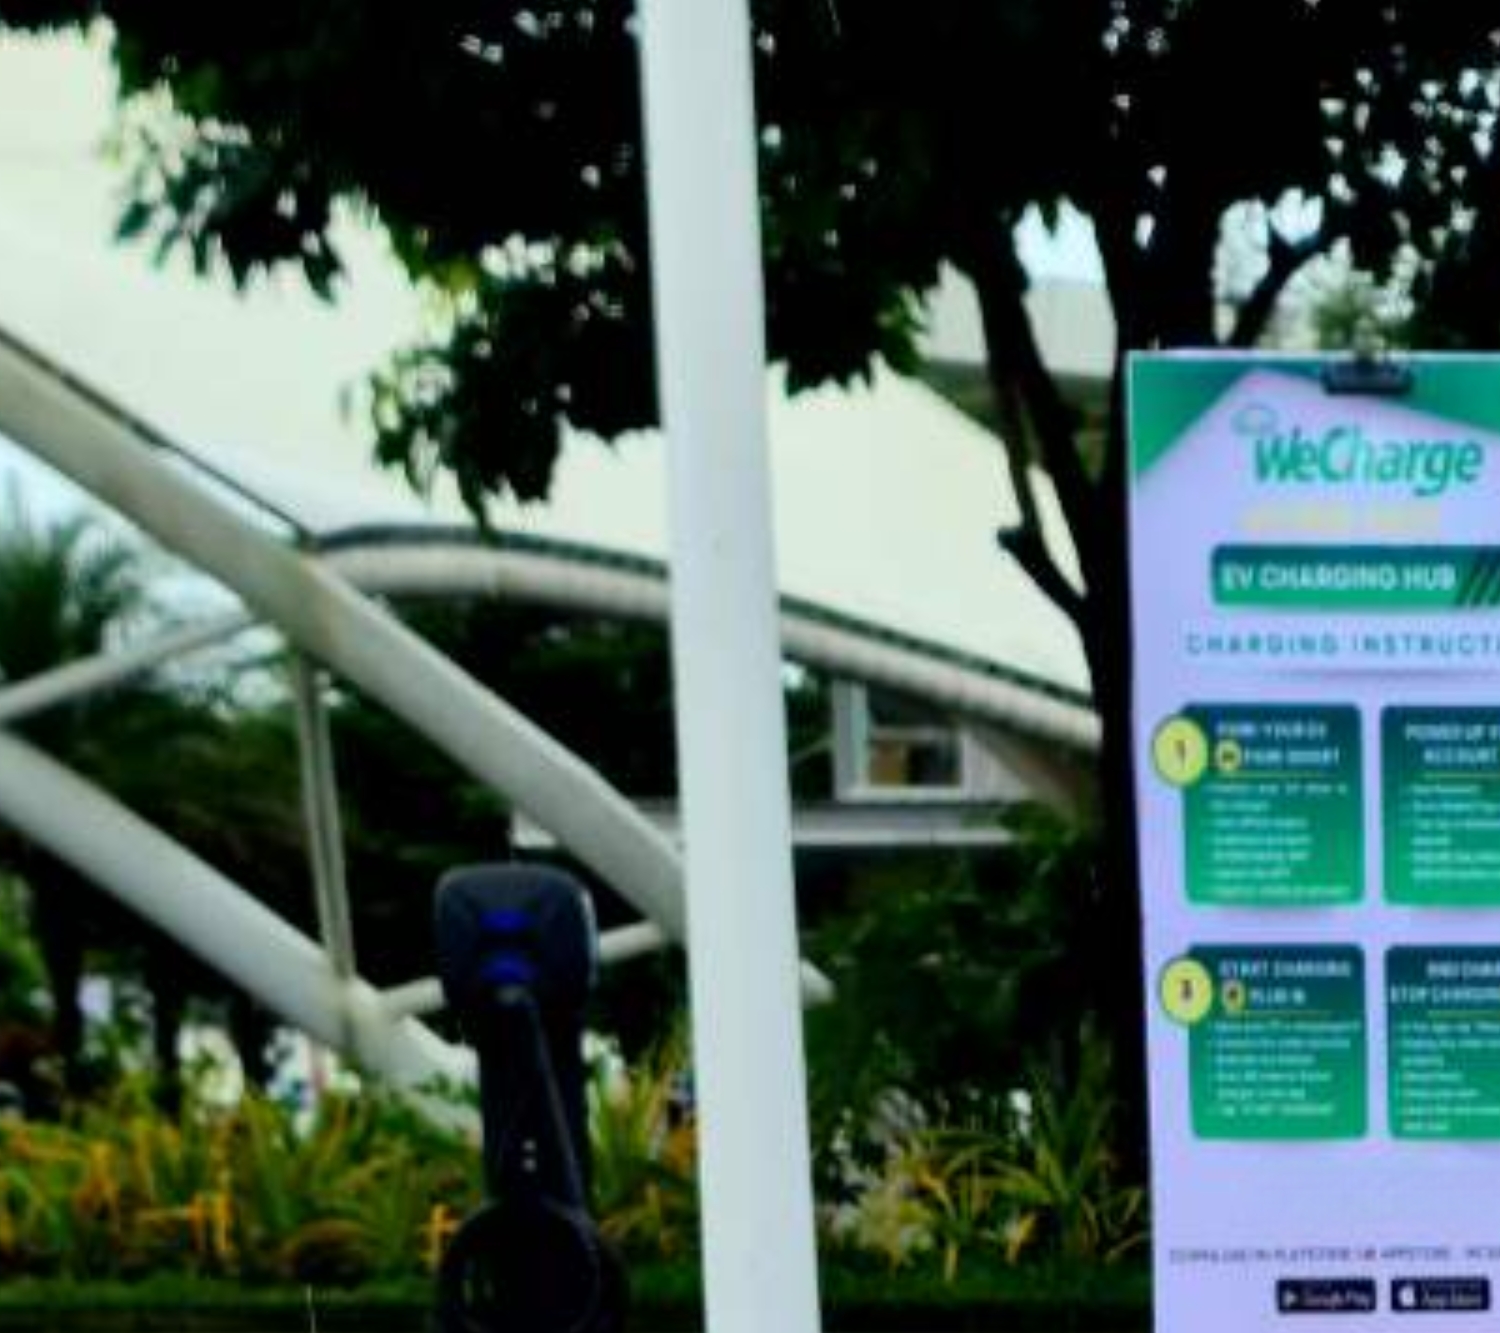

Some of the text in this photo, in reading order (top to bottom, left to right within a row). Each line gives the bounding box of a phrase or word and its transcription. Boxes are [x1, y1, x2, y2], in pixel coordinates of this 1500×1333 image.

[1255, 426, 1484, 496] WeCharge
[1224, 562, 1457, 591] EV CHARGING HUB
[1186, 633, 1338, 655] CHARGING
